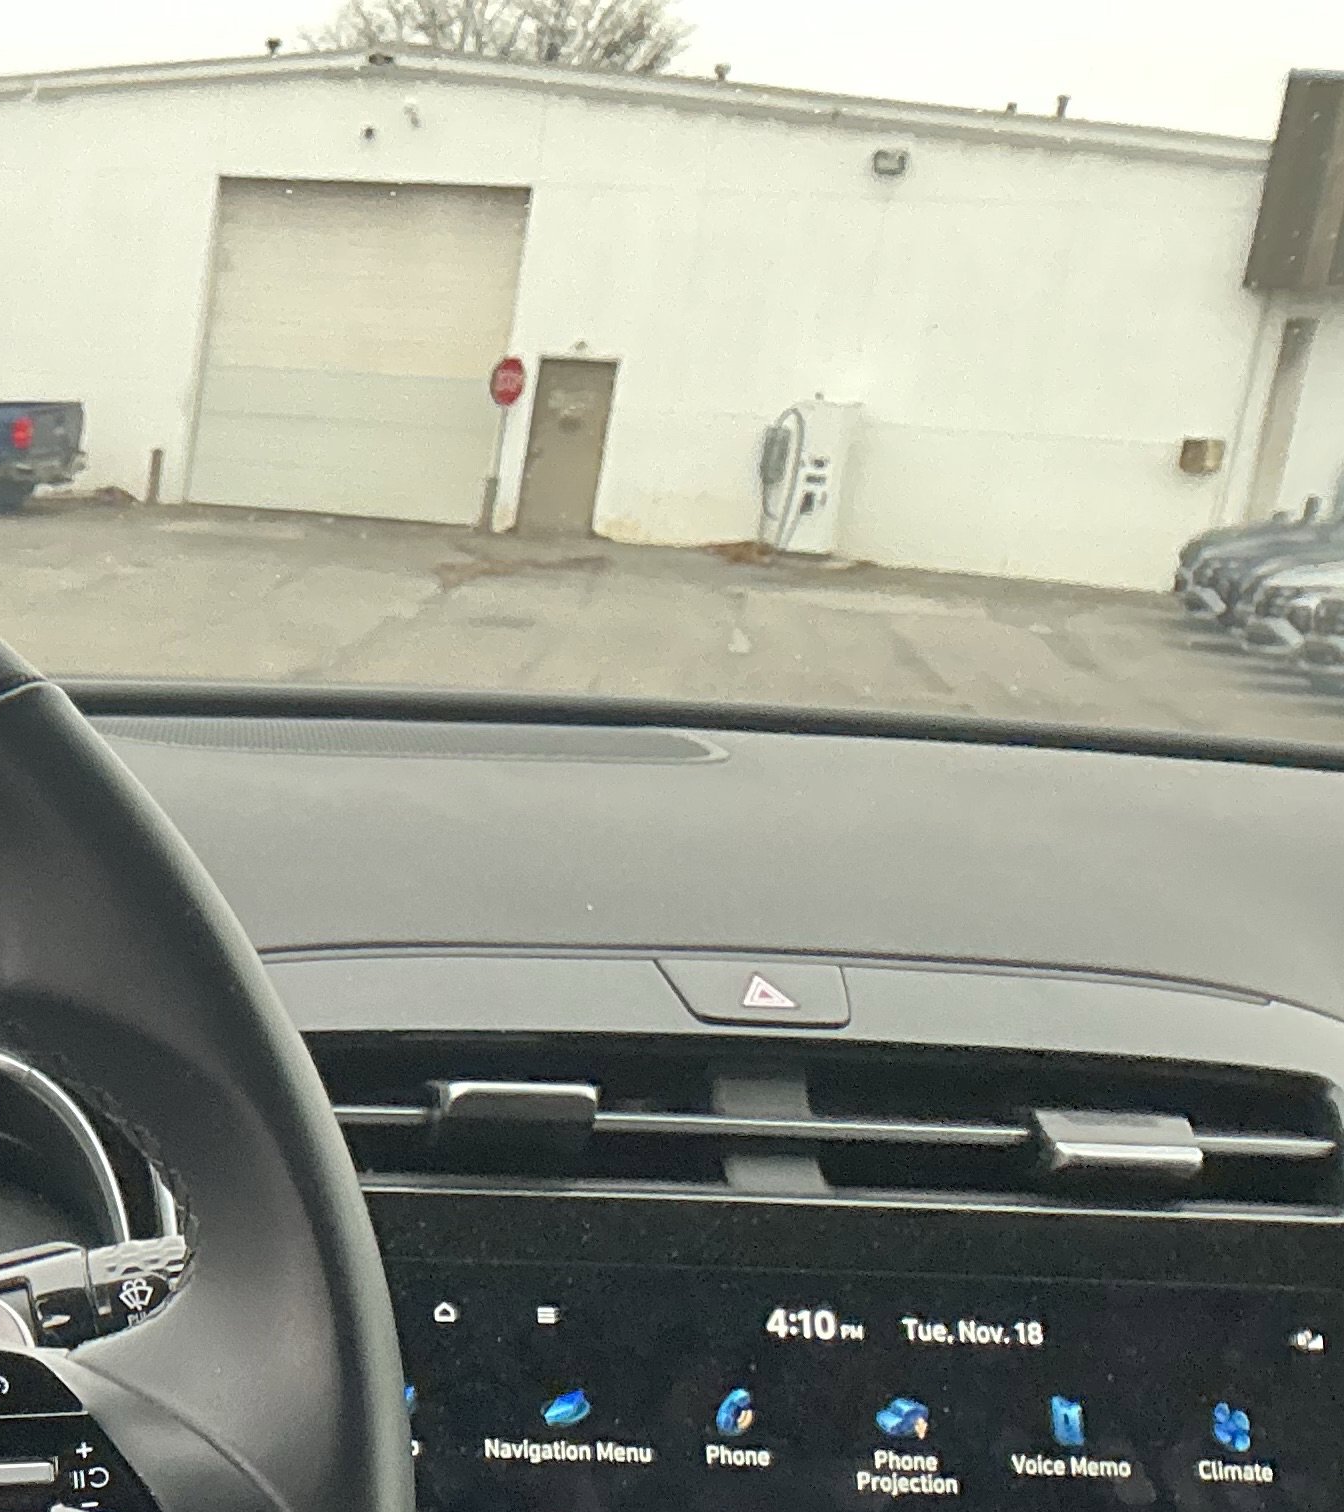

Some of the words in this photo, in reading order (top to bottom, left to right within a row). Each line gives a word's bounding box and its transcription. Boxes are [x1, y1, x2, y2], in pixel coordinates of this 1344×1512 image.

[766, 1308, 837, 1341] 4:10
[839, 1324, 865, 1341] PM
[958, 1319, 1011, 1345] Nov.
[1013, 1321, 1044, 1346] 18
[484, 1437, 592, 1464] Navigation
[596, 1440, 653, 1463] Menu
[705, 1444, 771, 1467] Phone
[873, 1449, 939, 1471] Phone
[1010, 1453, 1066, 1476] Voice
[1070, 1455, 1132, 1478] Memo
[1198, 1459, 1274, 1483] Climate
[856, 1472, 959, 1495] Projection
